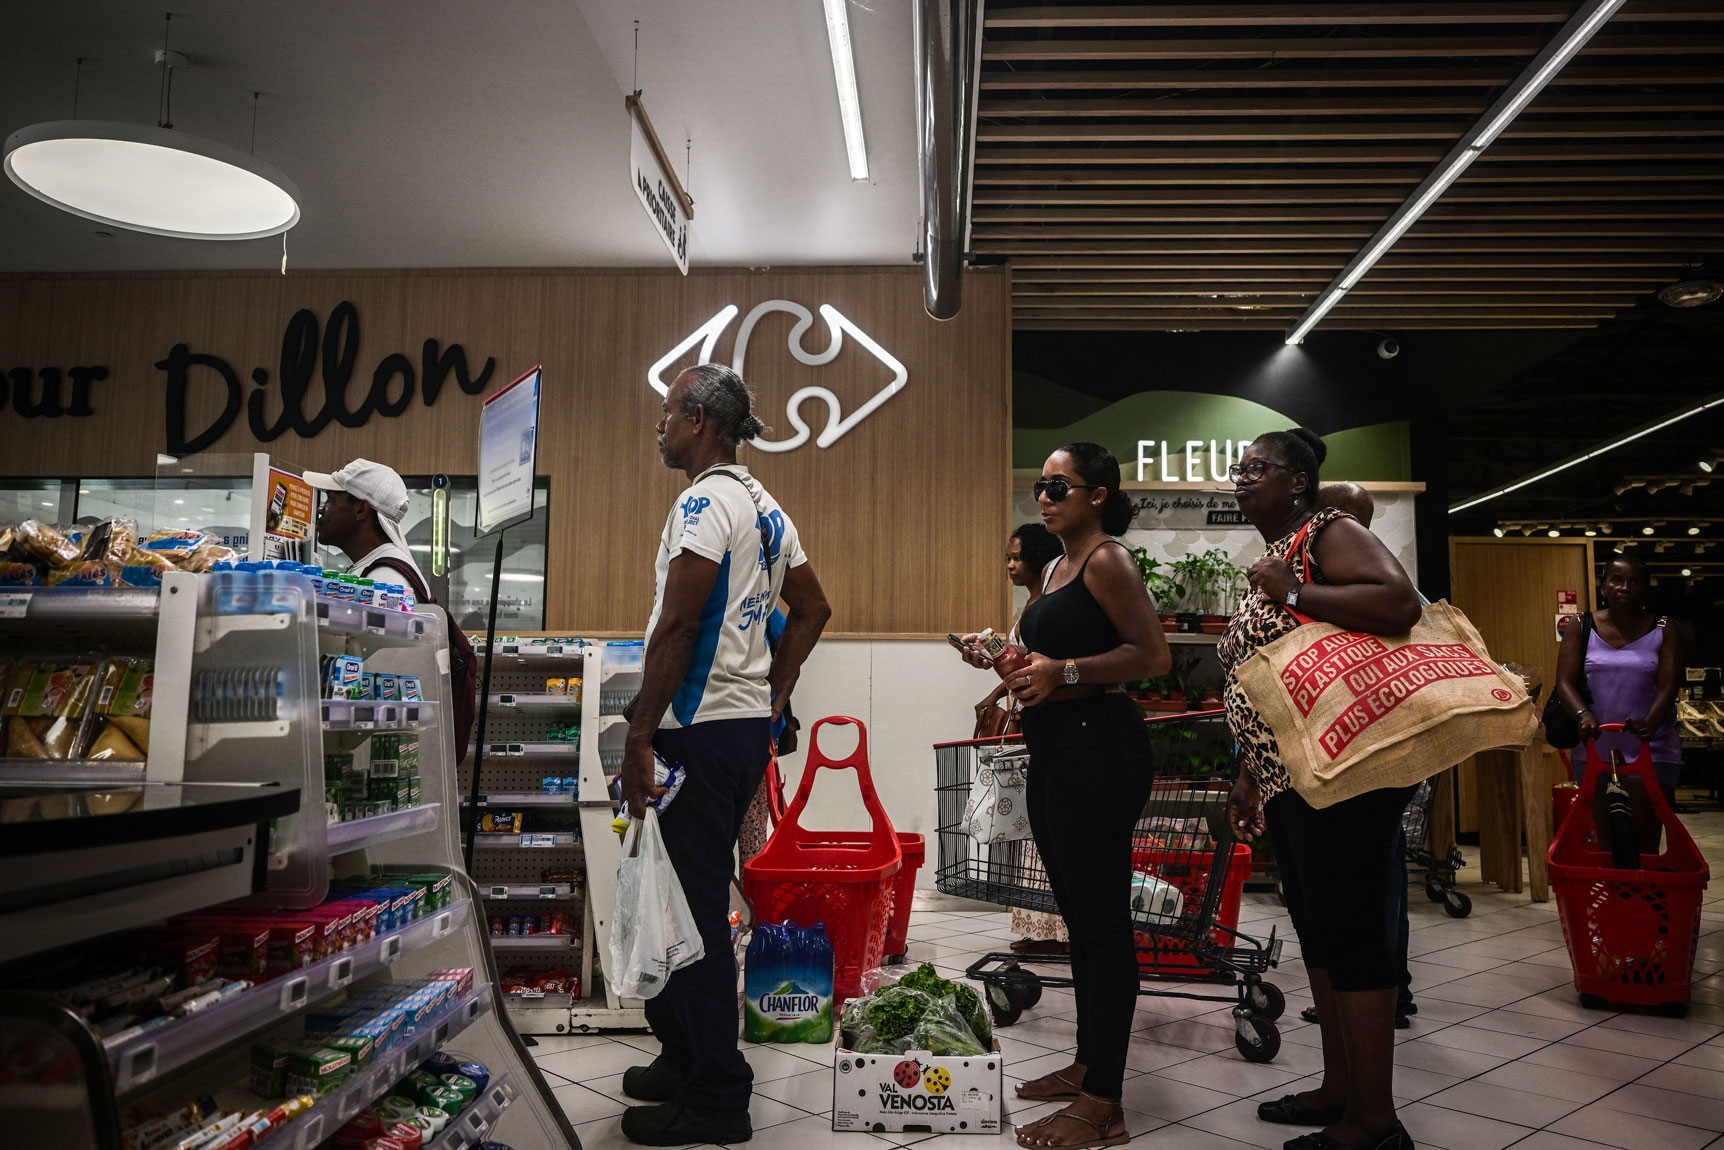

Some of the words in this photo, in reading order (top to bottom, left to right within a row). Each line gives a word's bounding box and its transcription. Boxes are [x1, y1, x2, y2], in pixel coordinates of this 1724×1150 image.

[643, 175, 676, 248] PRIORITAIRE
[658, 179, 676, 224] CAISSE
[0, 365, 107, 418] ur
[154, 301, 495, 459] Dillon
[680, 495, 711, 518] YOP
[1140, 498, 1158, 510] Ici,
[1158, 499, 1170, 514] je
[1171, 497, 1205, 509] choisis
[1206, 496, 1219, 509] de
[1221, 500, 1238, 509] me
[1212, 513, 1239, 523] FAIRE
[1283, 650, 1319, 691] STOP
[1322, 632, 1360, 653] AUX
[1296, 639, 1384, 712] PLASTIQUE
[1349, 663, 1384, 693] OUI
[1382, 650, 1420, 673] AUX
[1420, 645, 1468, 659] SACS
[1328, 704, 1370, 755] PLUS
[1372, 659, 1493, 711] ÉCOLOGIQUES
[759, 993, 819, 1013] CHANFLOR
[321, 1056, 350, 1073] HOLLYWOOD
[879, 1083, 898, 1093] VAL
[879, 1093, 955, 1111] VENOSTA
